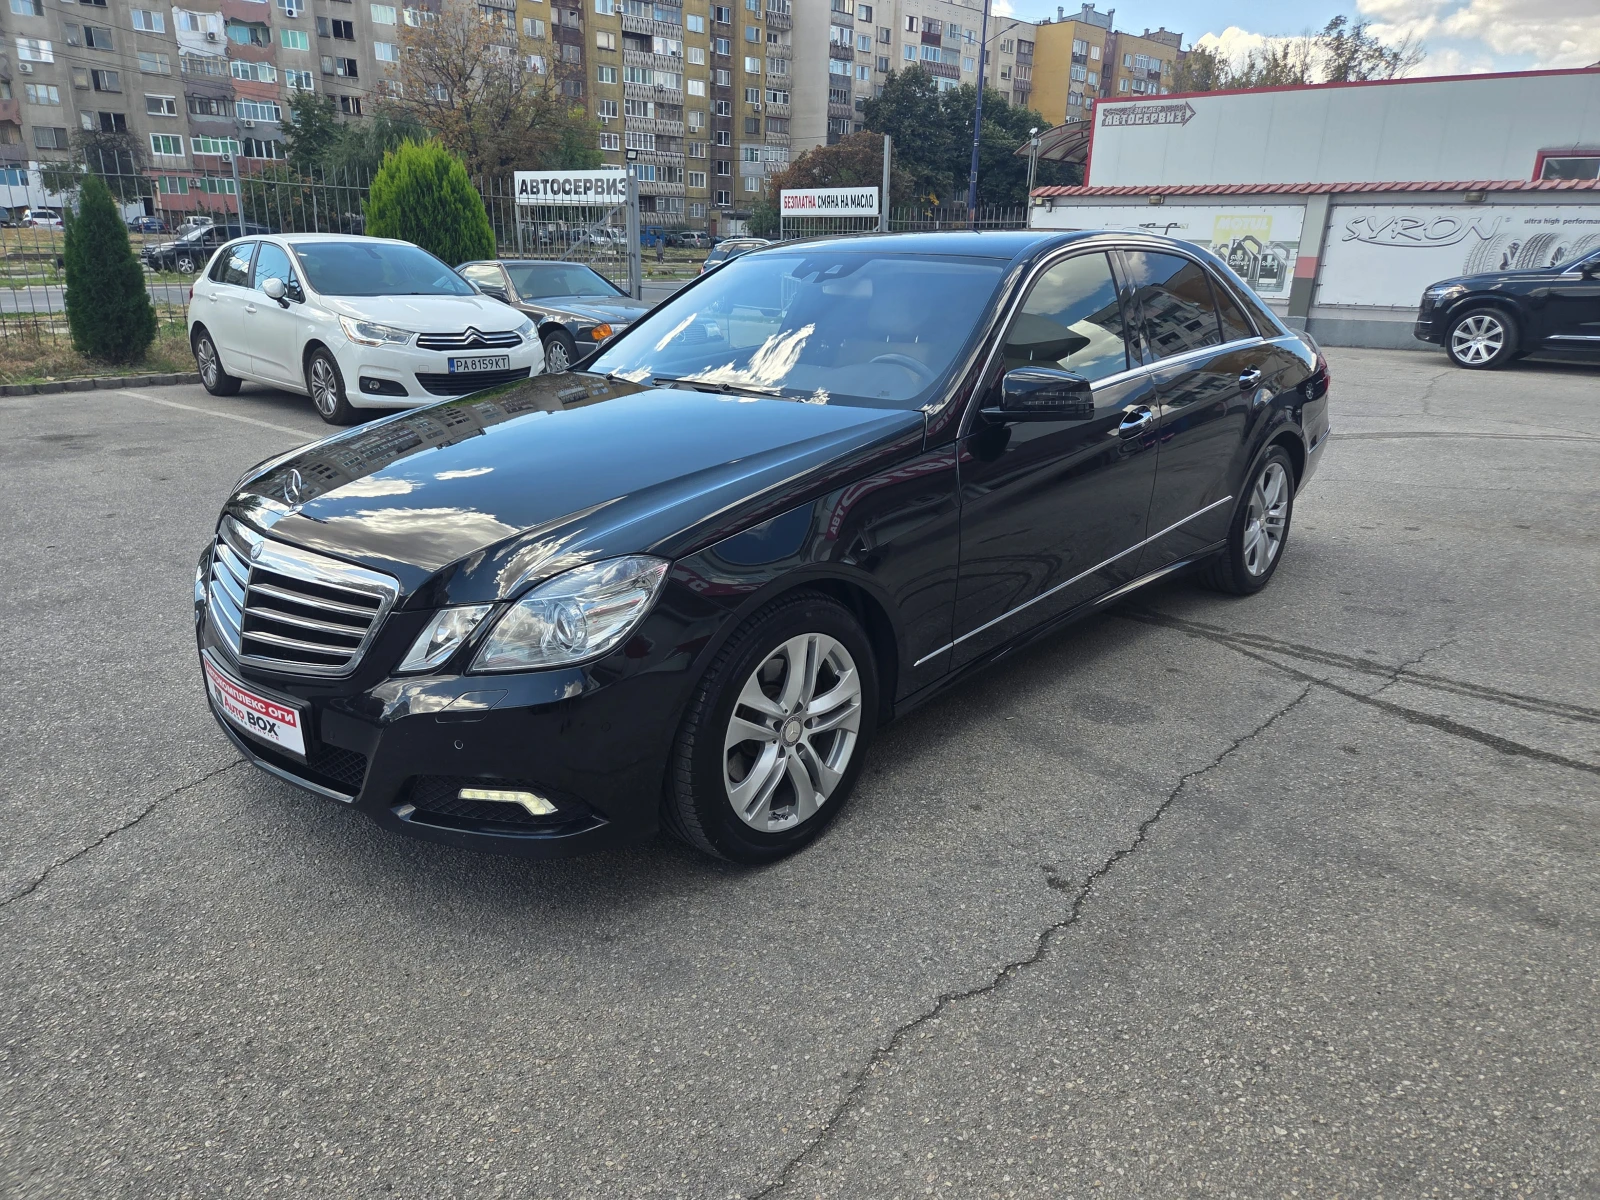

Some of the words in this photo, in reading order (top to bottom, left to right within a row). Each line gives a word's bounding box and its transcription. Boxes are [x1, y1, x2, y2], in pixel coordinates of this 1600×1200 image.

[1105, 111, 1183, 126] АВТОСЕРВИЗ
[519, 178, 627, 196] АВТОСЕРВИЗ
[784, 195, 816, 209] БЕЗПЛАТНА
[817, 194, 839, 209] СМЯНА
[840, 194, 849, 209] НА
[850, 193, 874, 209] МАСЛО
[1216, 217, 1269, 230] MOTUL
[1341, 215, 1502, 243] SYRON
[1543, 217, 1560, 225] high
[246, 710, 279, 737] BOX
[268, 706, 294, 724] ОГИ
